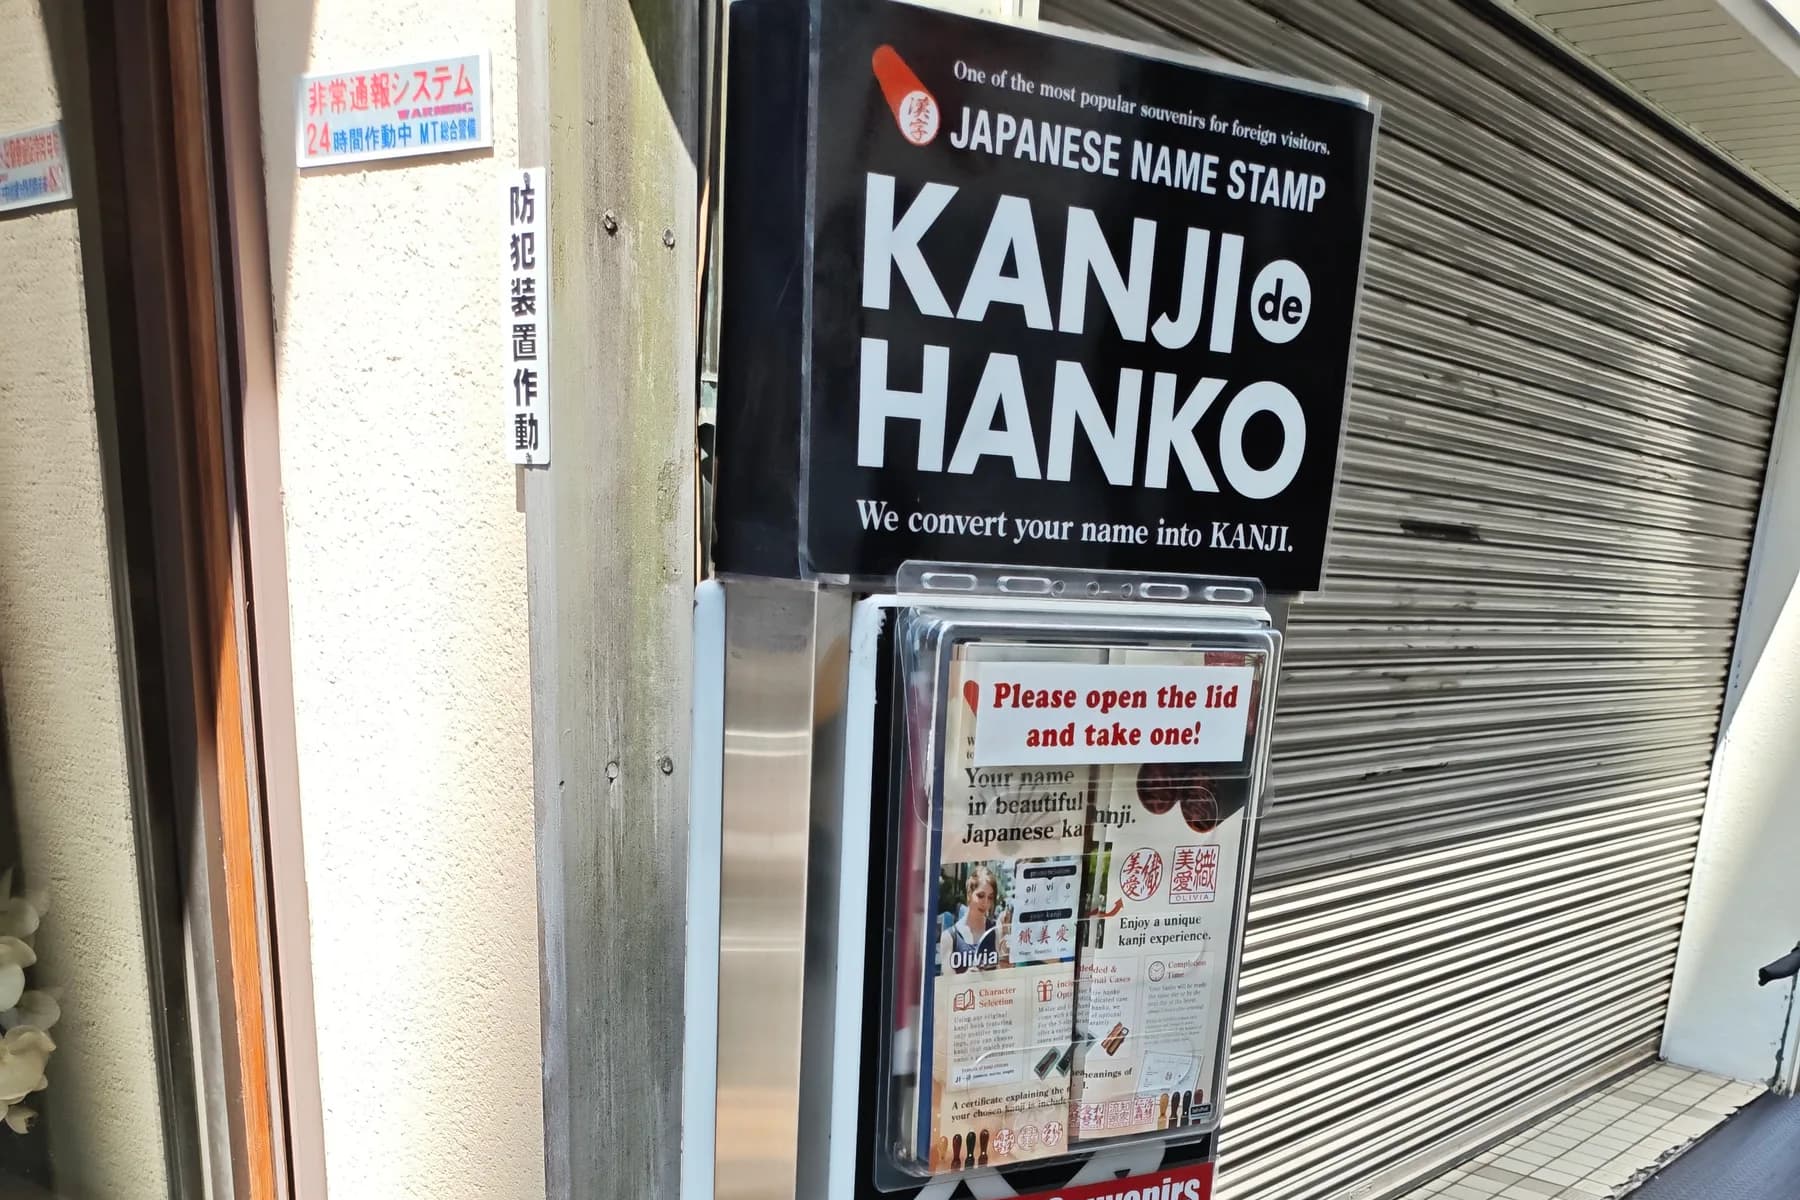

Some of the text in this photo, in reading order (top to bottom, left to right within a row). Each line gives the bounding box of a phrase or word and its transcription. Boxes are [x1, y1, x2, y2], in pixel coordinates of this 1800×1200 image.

[308, 64, 473, 116] 非常通報システム
[954, 60, 1330, 156] One of the most popular souvenirs for foreign visitors.
[307, 122, 412, 156] 24時間作動中
[950, 106, 1326, 213] JAPANESE NAME STAMP
[862, 171, 1303, 353] KANJI de
[510, 184, 538, 451] 防犯装置作動
[857, 337, 1306, 499] HANKO
[856, 500, 1294, 552] We convert your name into KANJI.
[993, 683, 1239, 713] Please open the lid
[1027, 721, 1201, 747] and take one!
[965, 768, 1074, 788] Your name
[968, 792, 1083, 816] in beautiful
[962, 823, 1054, 847] Japanese
[1120, 915, 1200, 929] Enjoy a unique
[1118, 932, 1211, 946] kanji experience.
[950, 950, 998, 969] Olivia
[979, 988, 1016, 997] Character
[979, 999, 1013, 1007] Selection
[952, 1087, 1064, 1110] A certificate explaining the
[952, 1112, 970, 1122] your
